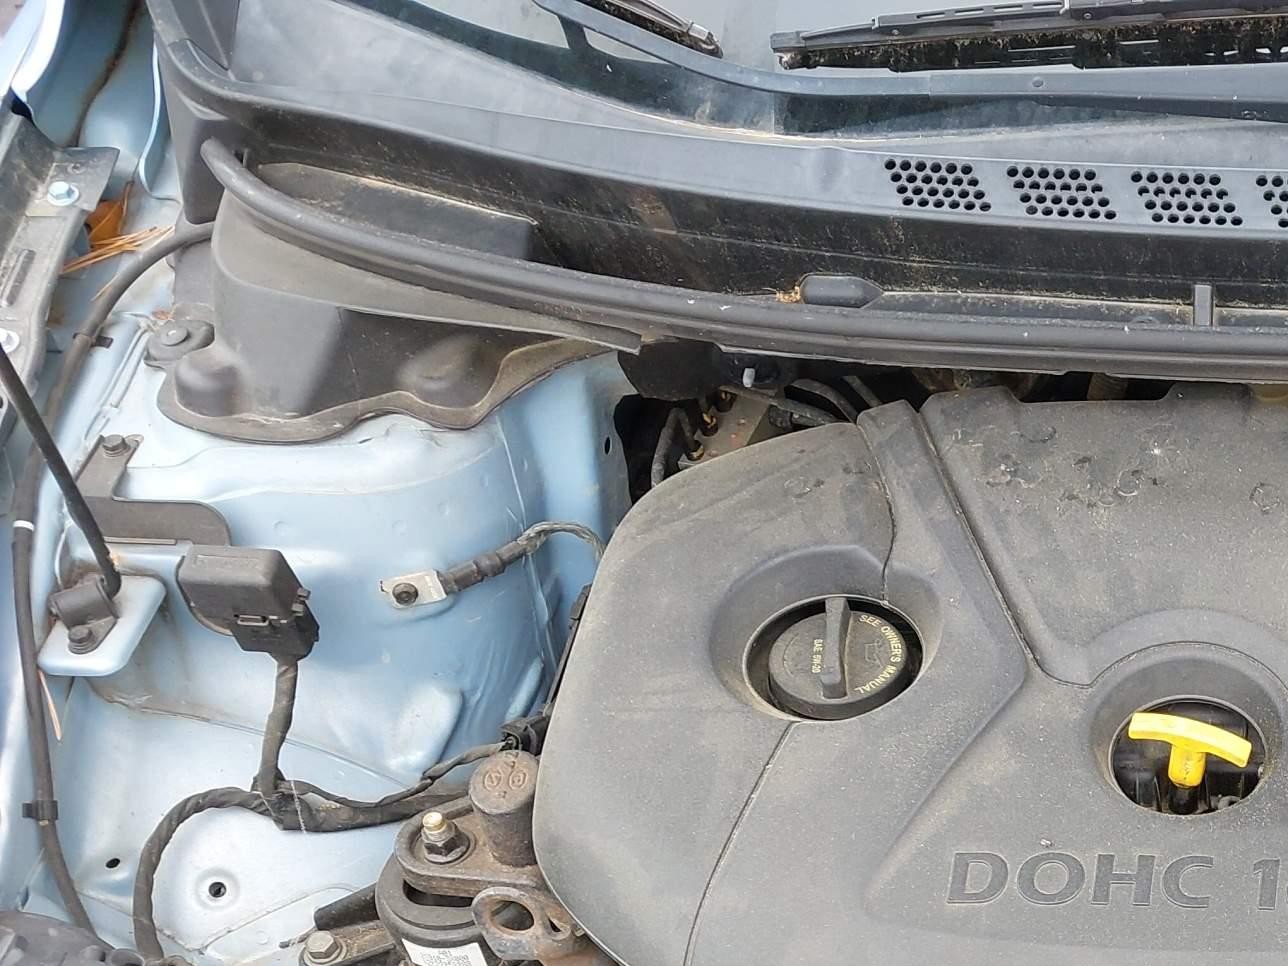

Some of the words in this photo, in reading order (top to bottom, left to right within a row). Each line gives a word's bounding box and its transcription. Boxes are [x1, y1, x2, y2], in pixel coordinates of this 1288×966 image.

[859, 614, 882, 628] SEE
[880, 625, 903, 663] OWNER'S
[854, 664, 897, 694] MANUAL
[945, 851, 1215, 909] DOHC
